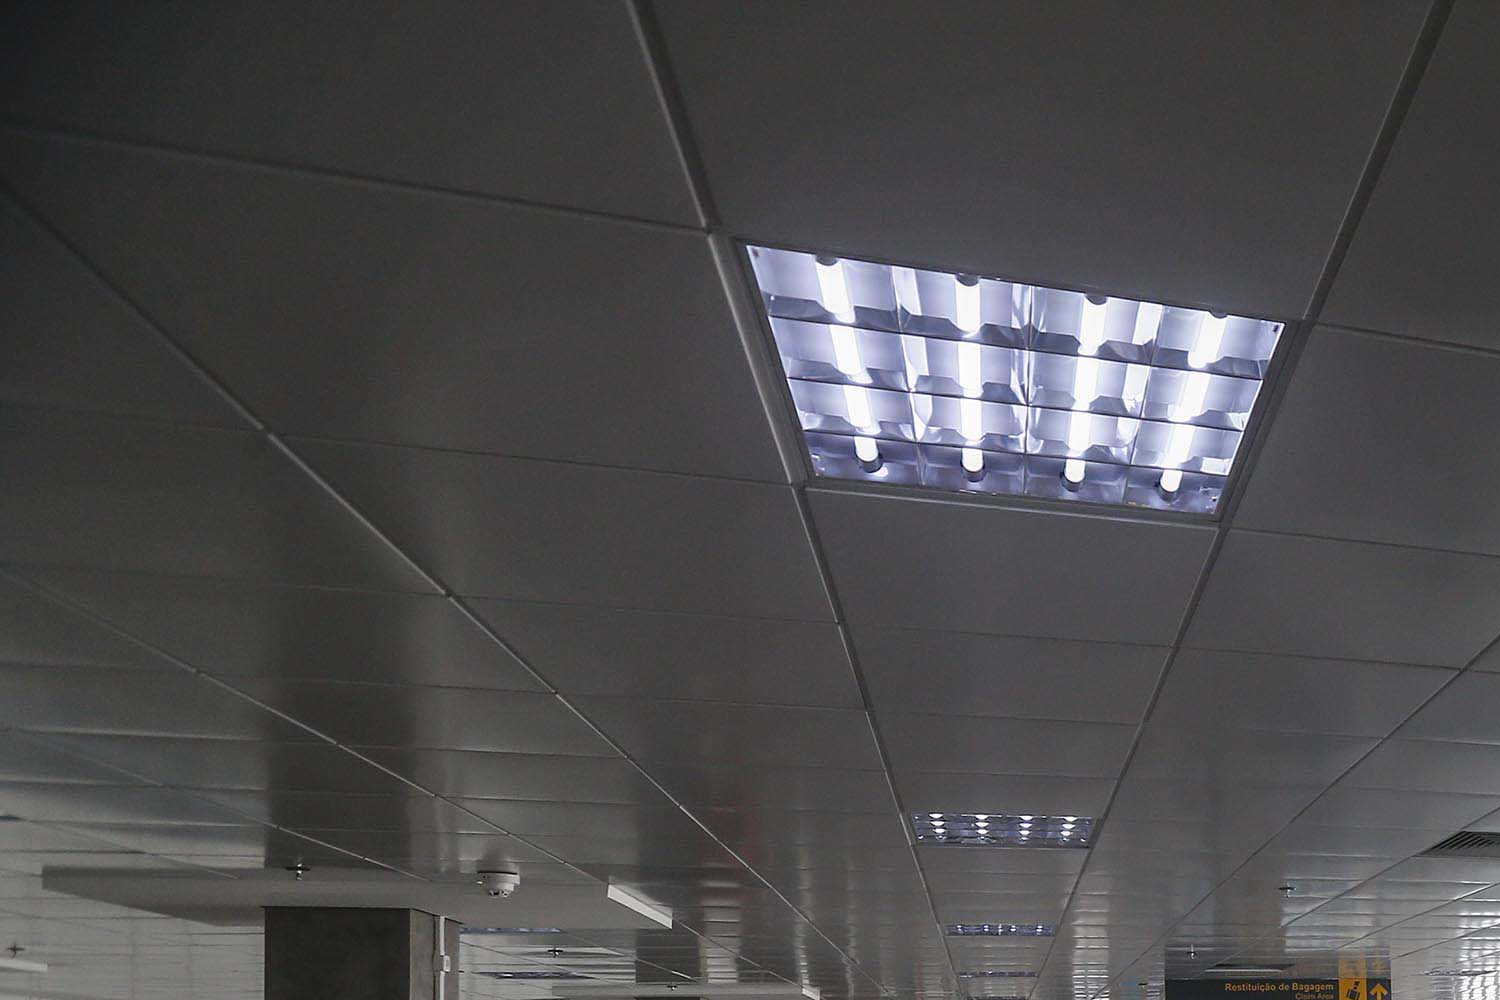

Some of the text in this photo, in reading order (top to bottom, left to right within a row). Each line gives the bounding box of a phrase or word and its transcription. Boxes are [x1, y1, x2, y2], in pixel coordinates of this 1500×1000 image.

[1224, 982, 1334, 992] Restituição de Bagagem
